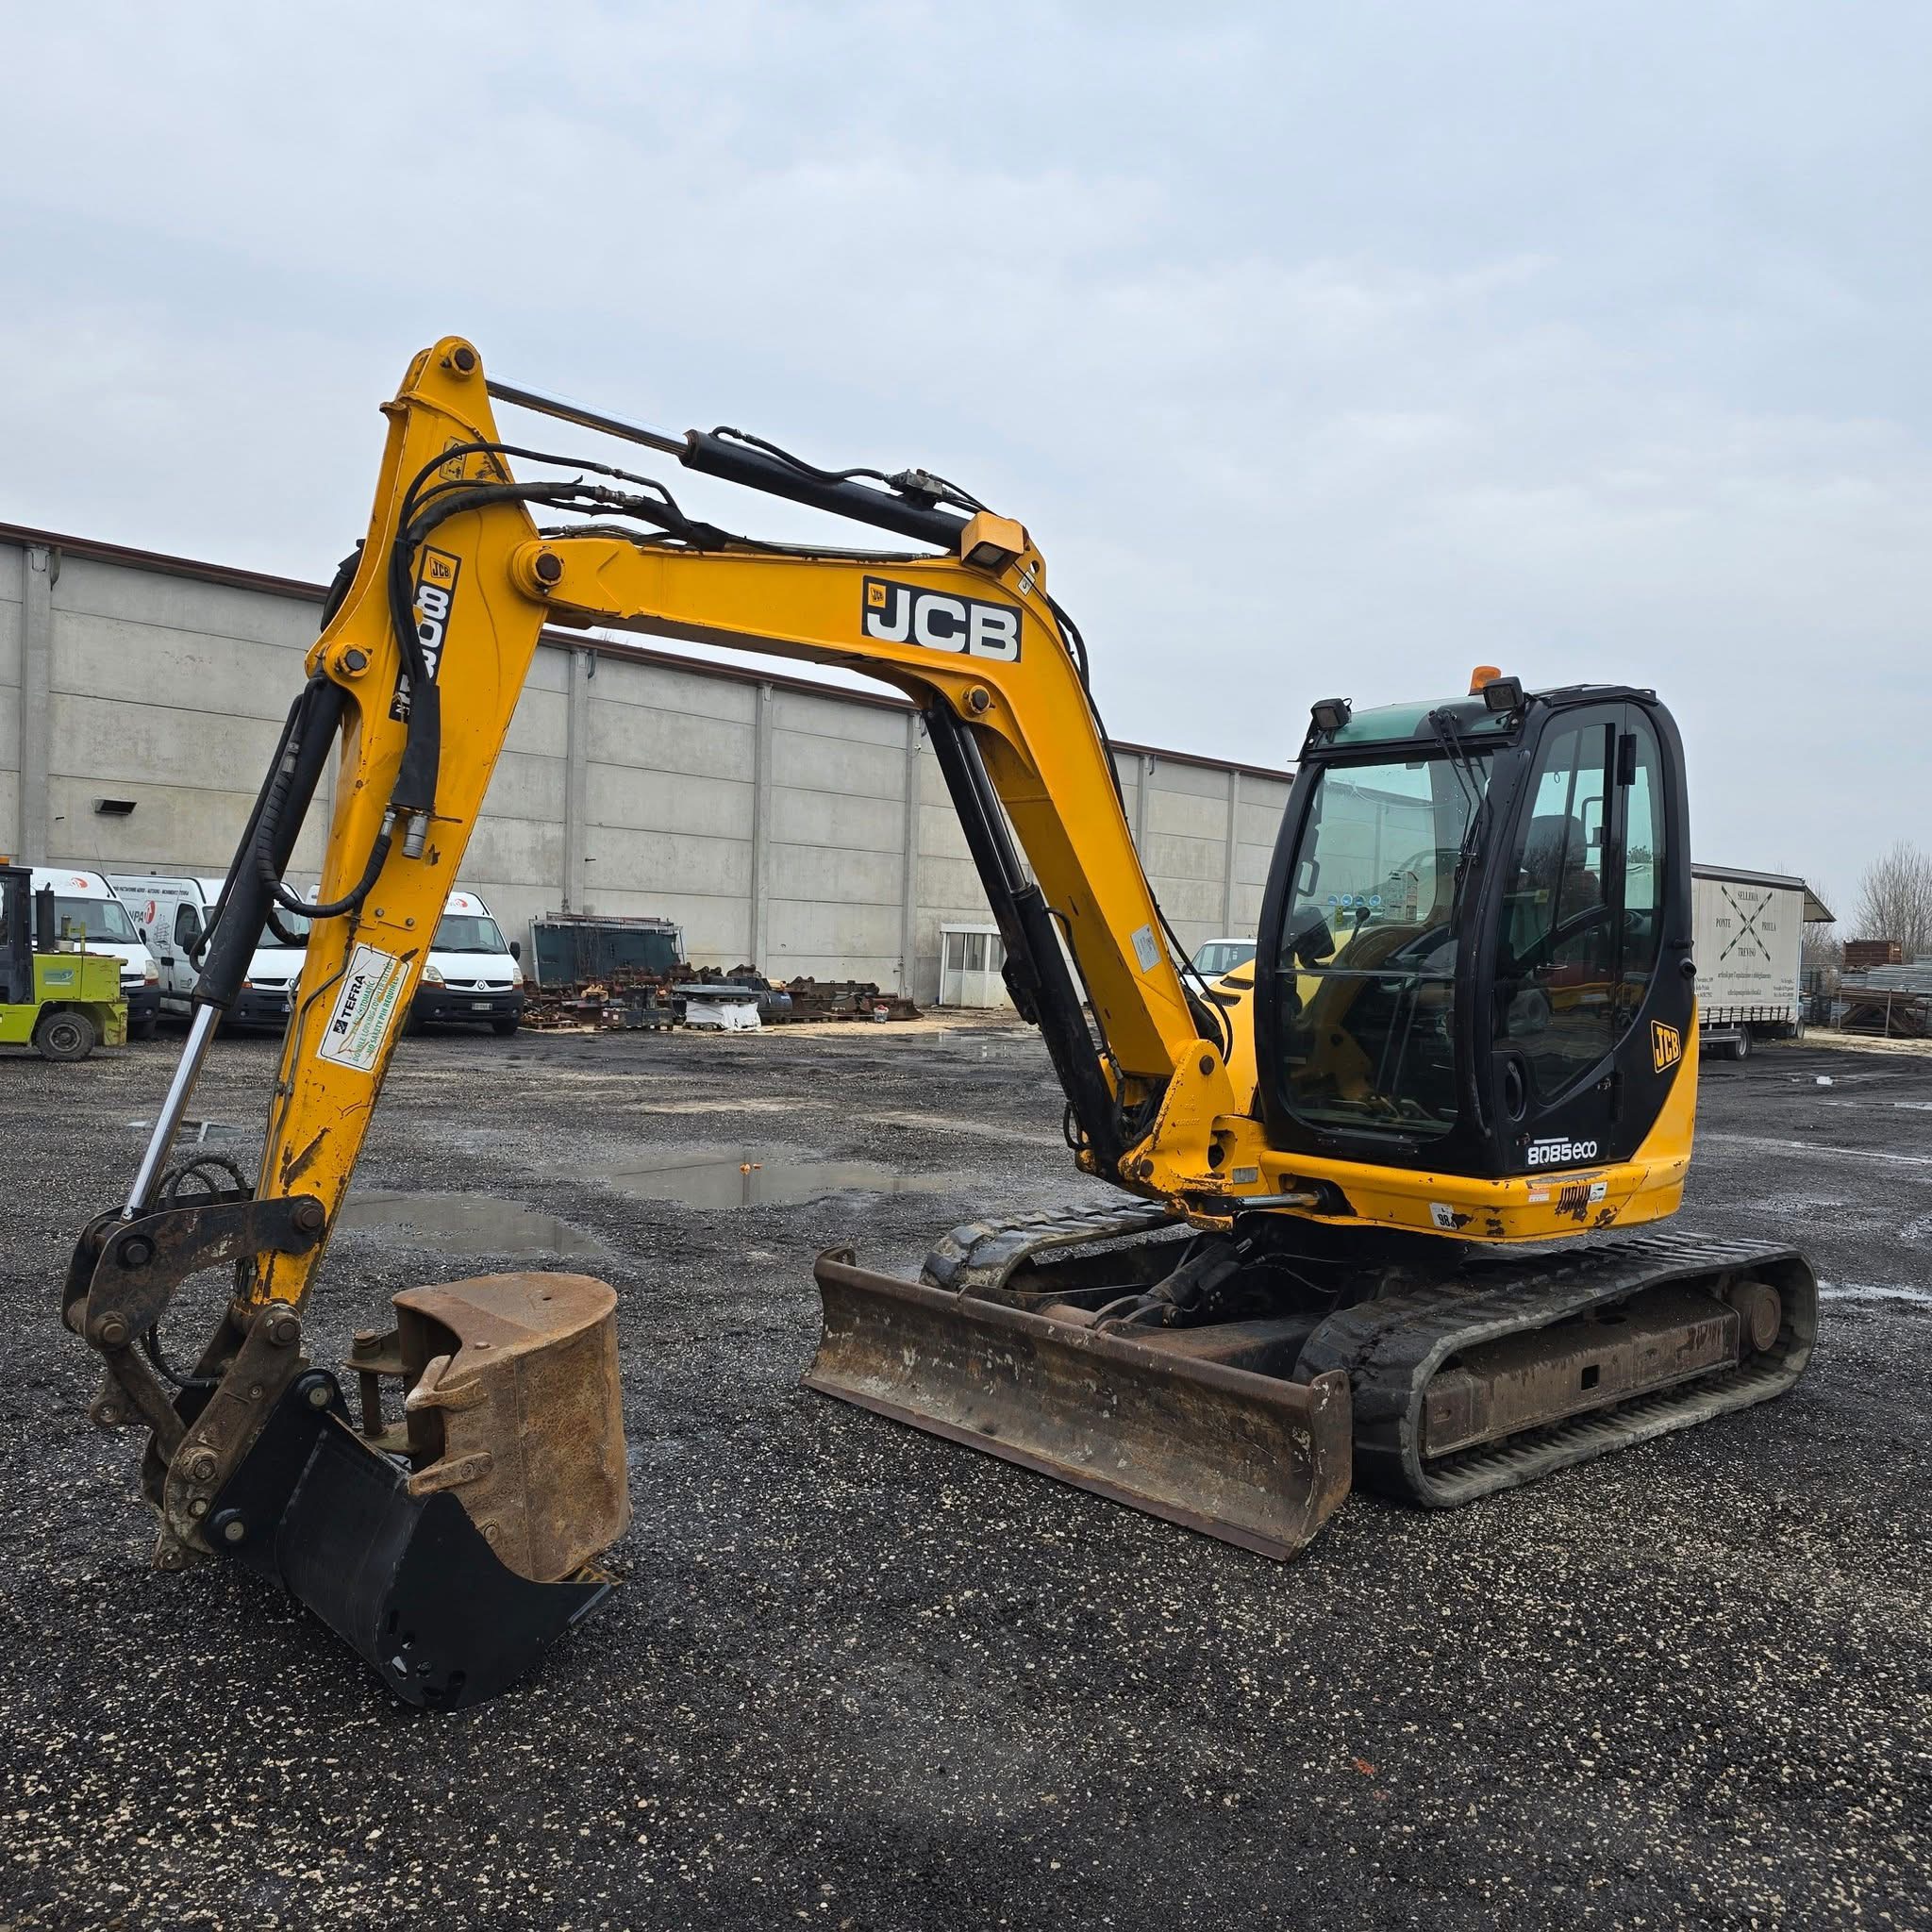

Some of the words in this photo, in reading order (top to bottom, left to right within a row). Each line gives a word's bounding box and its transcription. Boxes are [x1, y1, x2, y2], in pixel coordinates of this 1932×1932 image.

[432, 558, 451, 578] JCB
[867, 590, 1018, 662] JCB
[129, 910, 144, 923] NPA
[1716, 918, 1731, 928] PONTE
[1738, 947, 1756, 958] TREVISO
[341, 975, 365, 1019] TEFRA
[369, 1020, 383, 1043] SAFETY
[377, 1008, 387, 1020] PIN
[382, 975, 399, 1008] REQUIRED
[1656, 1026, 1679, 1067] JCB
[1527, 1141, 1597, 1165] 8085eco
